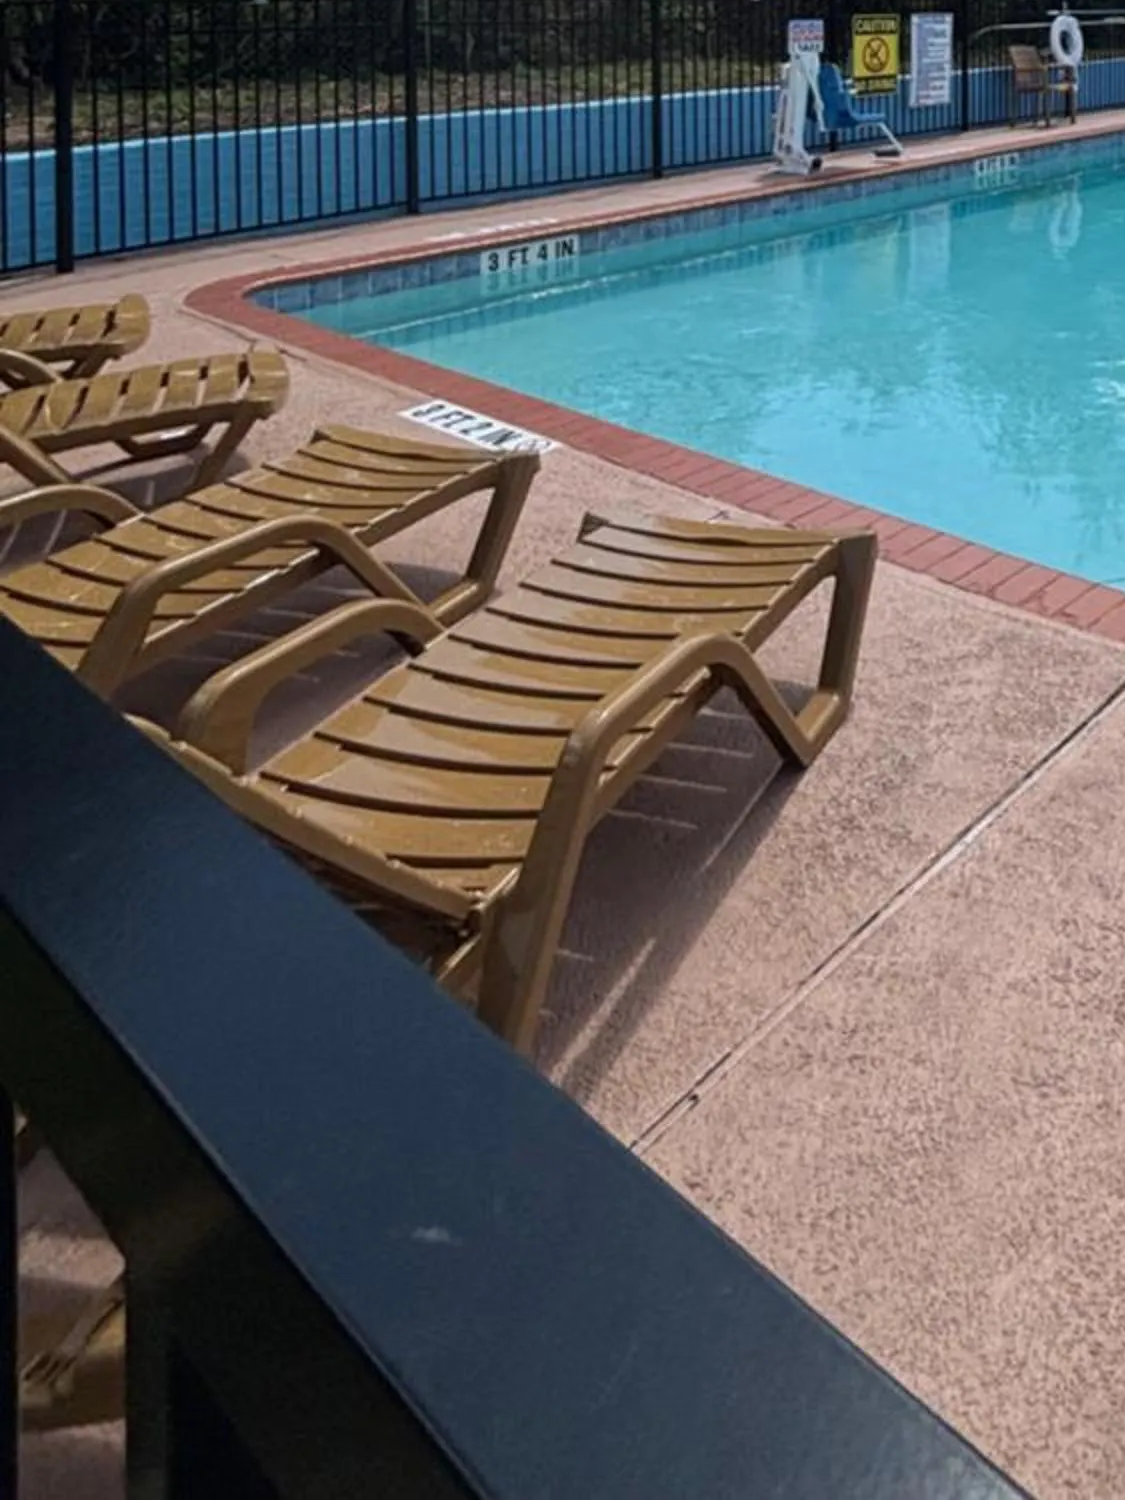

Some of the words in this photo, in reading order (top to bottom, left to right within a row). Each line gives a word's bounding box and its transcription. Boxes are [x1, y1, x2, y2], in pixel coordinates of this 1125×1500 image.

[488, 252, 499, 272] 3
[508, 246, 529, 268] FT
[537, 243, 548, 261] 4
[555, 239, 574, 259] IN
[428, 410, 474, 428] FT
[478, 428, 523, 445] IN
